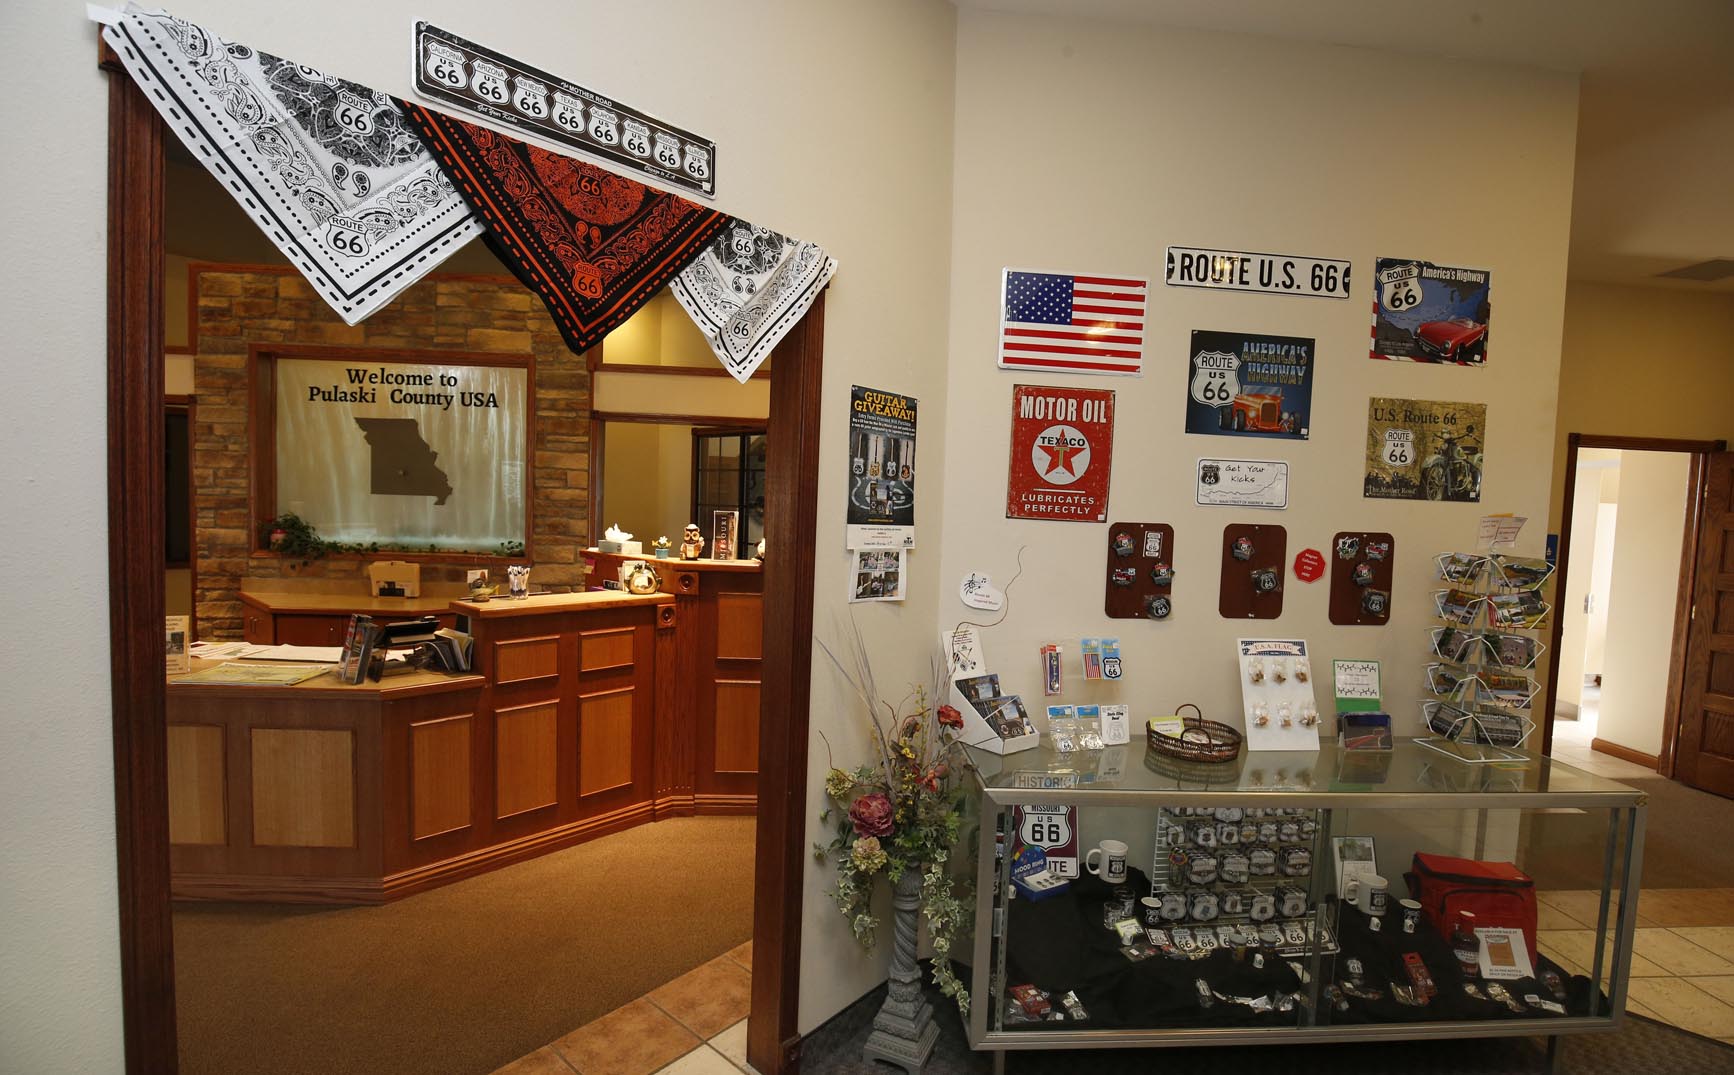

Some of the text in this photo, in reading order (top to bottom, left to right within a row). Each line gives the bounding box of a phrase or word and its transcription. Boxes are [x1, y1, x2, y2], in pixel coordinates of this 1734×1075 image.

[431, 44, 463, 61] CALIFORNIA
[440, 58, 454, 68] US
[477, 63, 504, 77] ARIZONA
[434, 64, 459, 84] 66
[484, 75, 497, 84] US
[479, 81, 502, 100] 66
[517, 79, 545, 95] NEW MEXICO
[342, 93, 369, 111] ROUTE
[525, 91, 537, 100] US
[560, 96, 578, 108] TEXAS
[569, 86, 594, 100] MOTHER
[595, 95, 612, 107] ROAD
[520, 97, 542, 115] 66
[563, 106, 574, 114] US
[340, 108, 367, 131] 66
[558, 112, 579, 129] 66
[592, 109, 616, 123] OKLAHOMA
[594, 125, 613, 142] 66
[627, 123, 647, 135] KANSAS
[628, 138, 645, 154] 66
[657, 135, 679, 147] MISSOURI
[659, 150, 676, 166] 66
[689, 162, 704, 176] 66
[581, 177, 600, 195] 66
[332, 216, 363, 232] ROUTE
[333, 234, 363, 254] 66
[736, 239, 751, 253] 66
[578, 265, 598, 275] ROUTE
[1180, 253, 1338, 292] ROUTE U.S. 66
[1387, 268, 1413, 280] ROUTE
[1422, 266, 1485, 283] America's Highway
[578, 276, 598, 294] 66
[1394, 281, 1409, 289] US
[1391, 288, 1417, 308] 66
[733, 321, 749, 336] 66
[1241, 341, 1308, 365] AMERICA'S
[1202, 356, 1233, 368] ROUTE
[346, 368, 458, 387] Welcome to
[1209, 371, 1226, 379] US
[1247, 362, 1306, 385] HIGHWAY
[308, 385, 499, 410] Pulaski County USA
[1203, 381, 1230, 401] 66
[865, 391, 907, 409] GUITAR
[854, 400, 915, 422] GIVEAWAY!
[1020, 396, 1107, 423] MOTOR OIL
[1374, 408, 1457, 425] U.S. Route 66
[1040, 436, 1085, 447] TEXACO
[1388, 432, 1410, 440] ROUTE
[1389, 449, 1408, 463] 66
[1231, 474, 1255, 483] Kicks
[1022, 494, 1095, 505] LUBRICATES
[1024, 504, 1091, 514] PERFECTLY
[1019, 776, 1072, 788] HISTORIC
[1032, 823, 1060, 843] 66
[1148, 915, 1160, 923] 66
[1178, 940, 1191, 949] 66
[1201, 939, 1214, 947] 66
